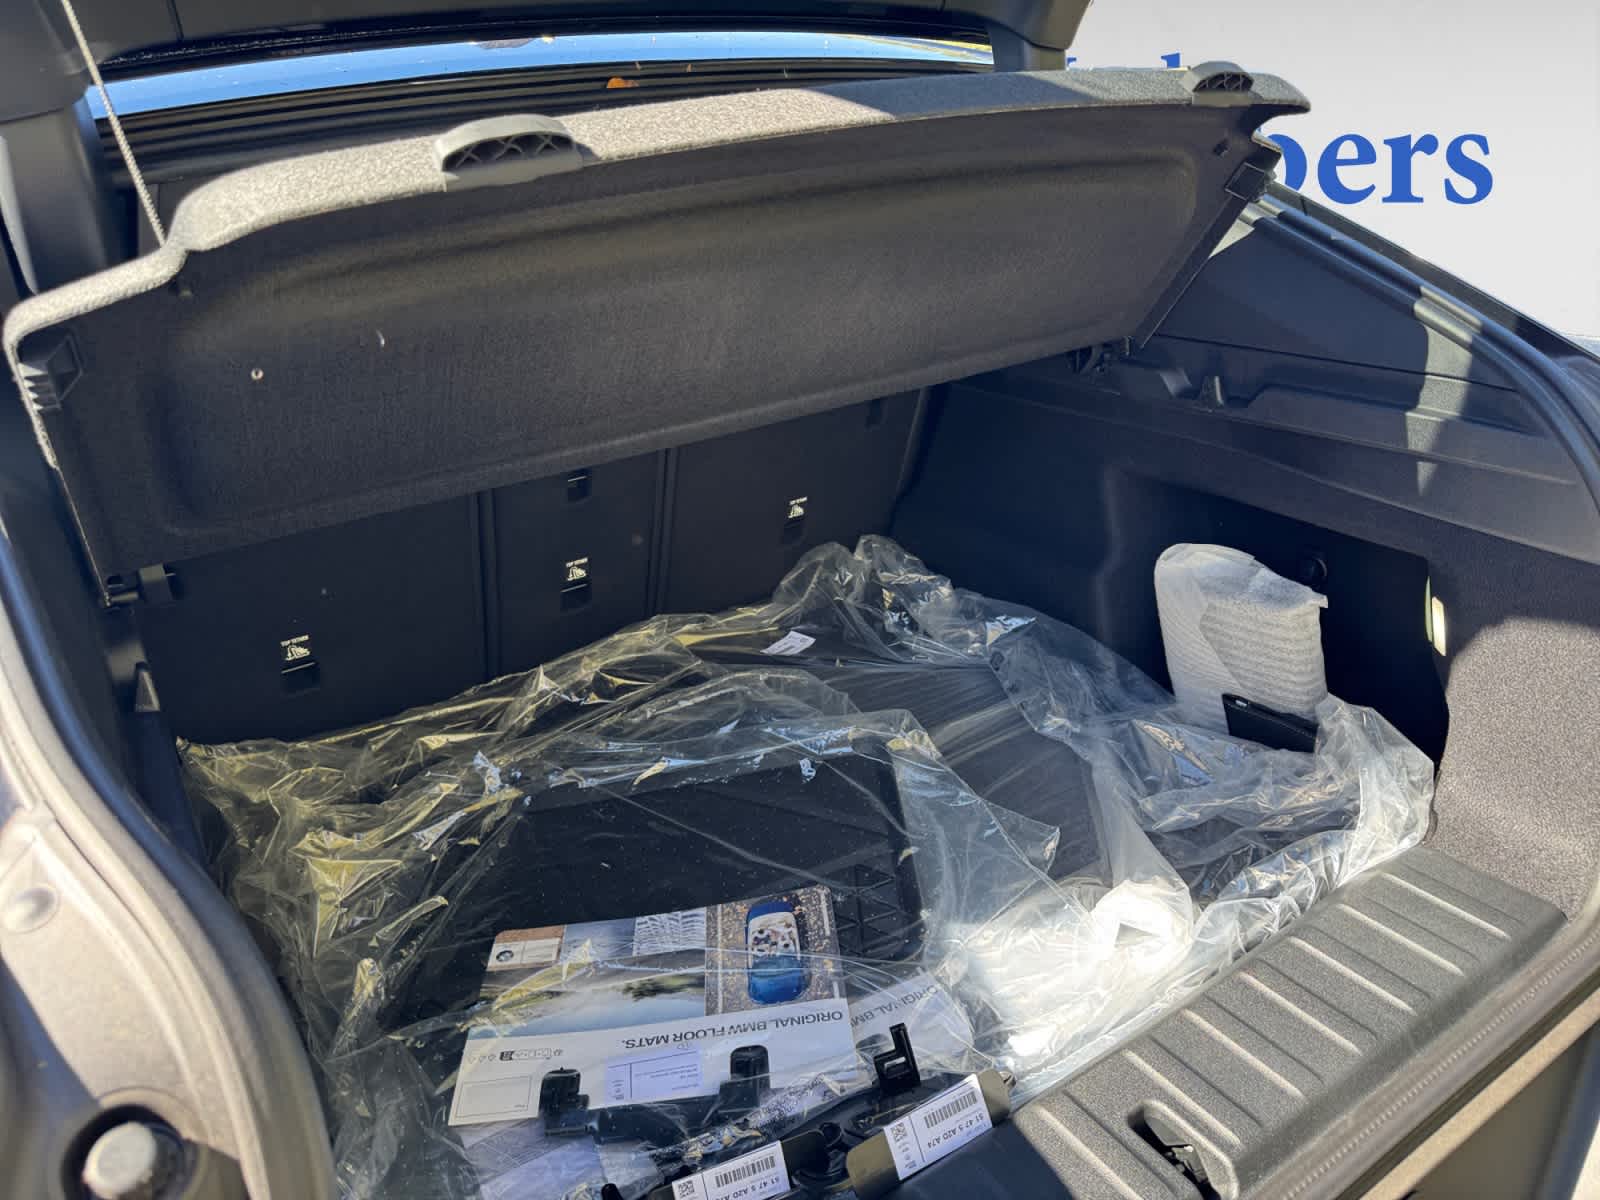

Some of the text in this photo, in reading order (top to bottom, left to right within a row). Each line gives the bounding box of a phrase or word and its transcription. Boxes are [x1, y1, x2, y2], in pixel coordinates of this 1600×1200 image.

[621, 1010, 843, 1049] ORIGINAL BMW FLOOR MATS.
